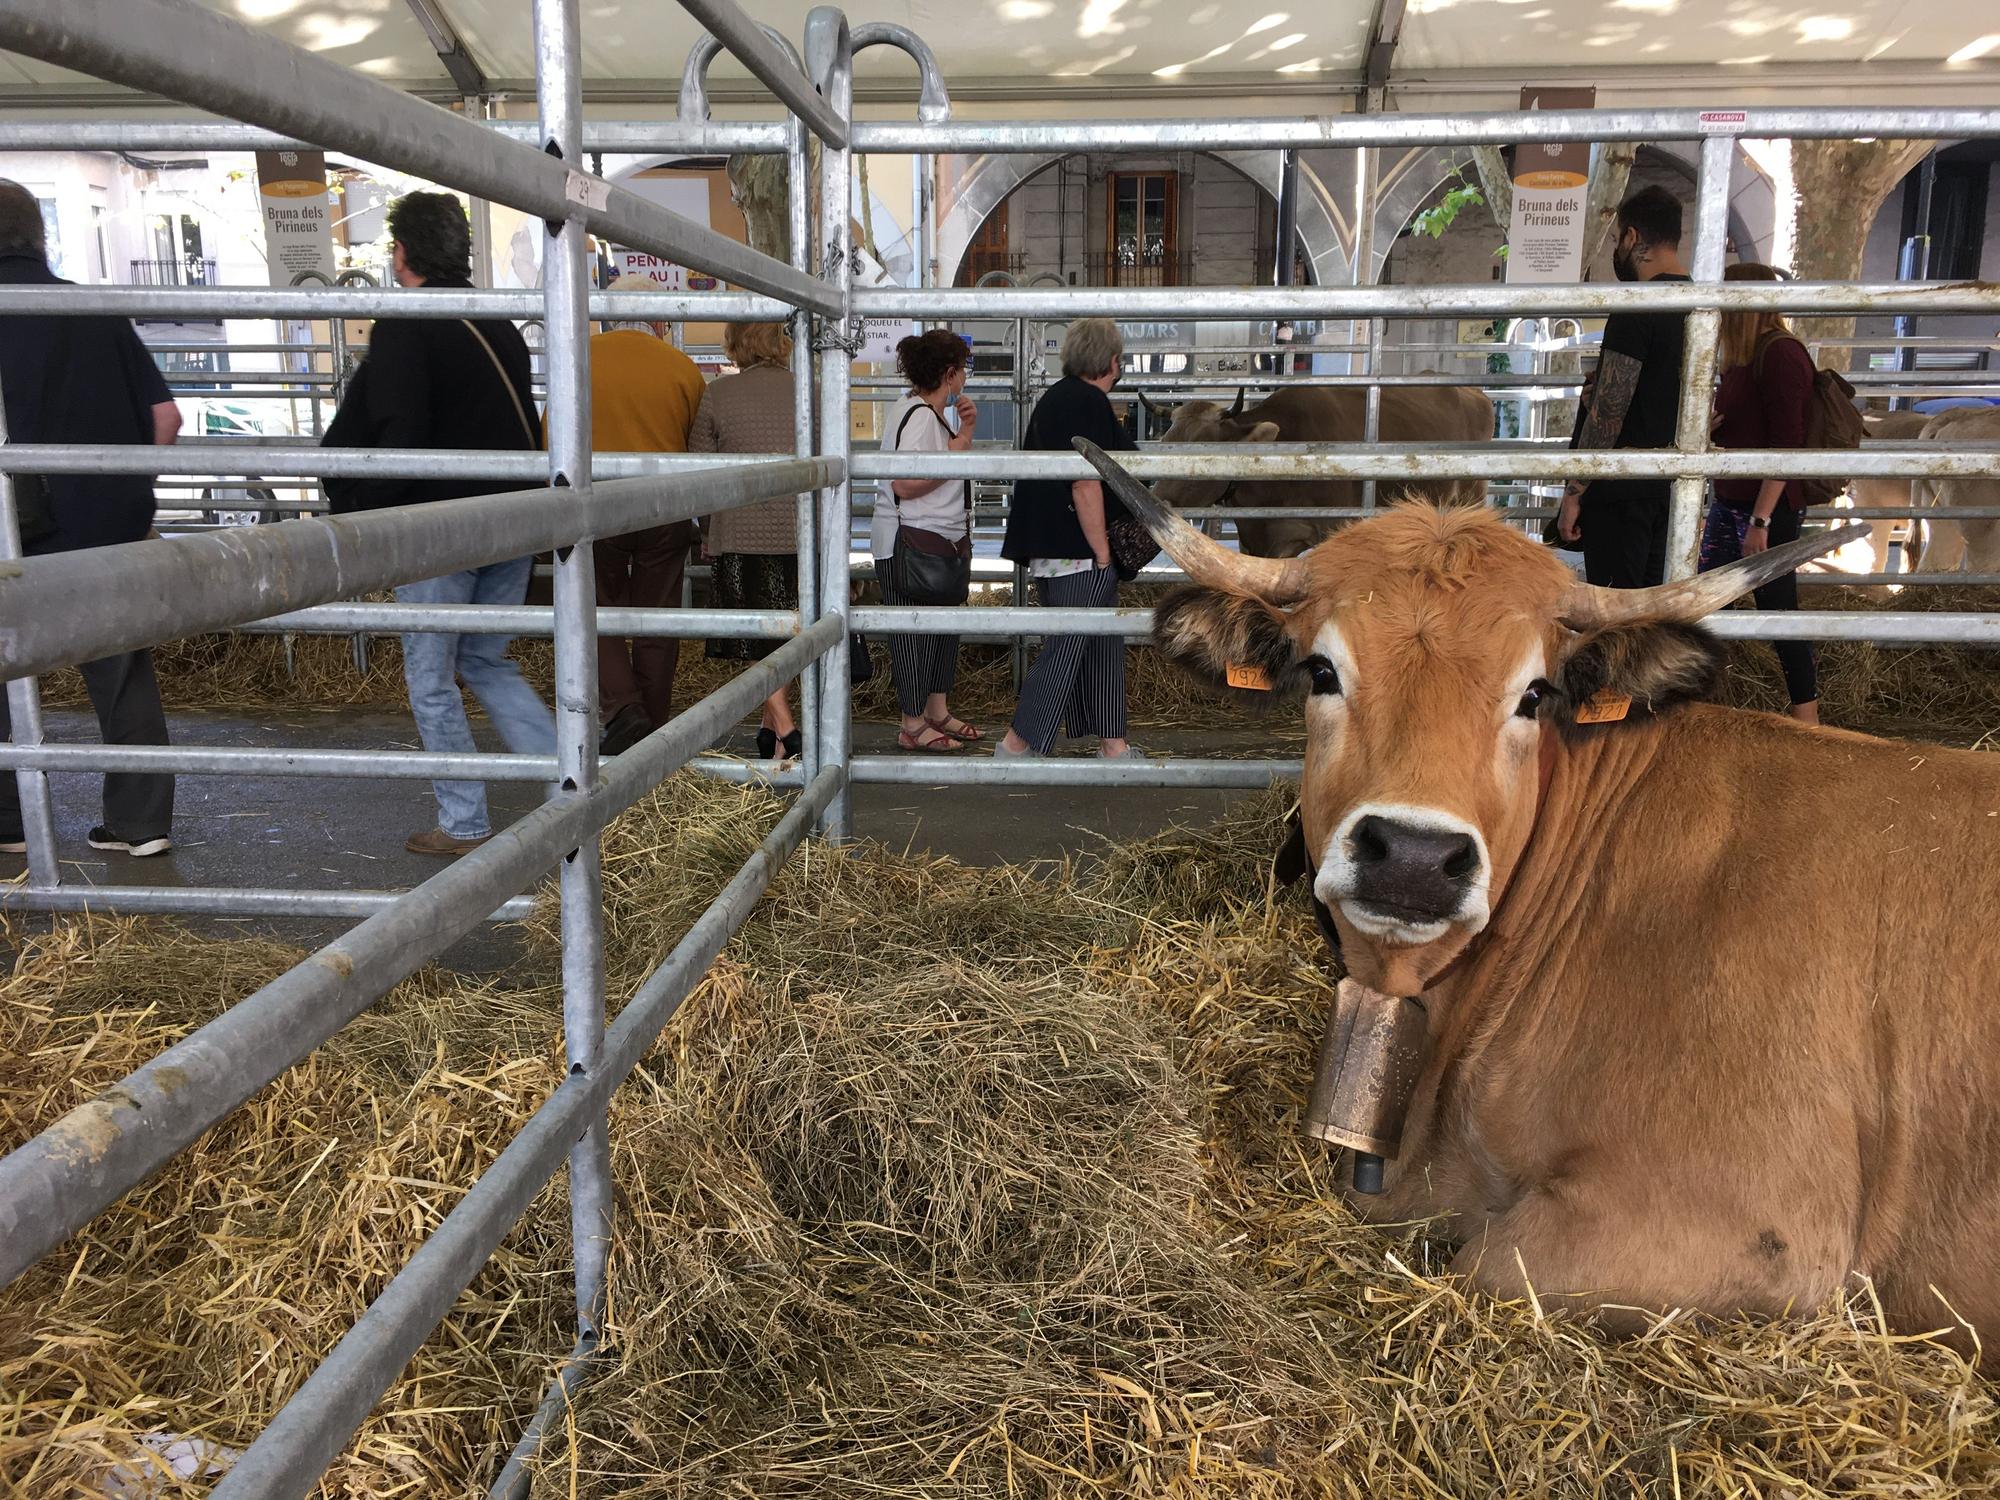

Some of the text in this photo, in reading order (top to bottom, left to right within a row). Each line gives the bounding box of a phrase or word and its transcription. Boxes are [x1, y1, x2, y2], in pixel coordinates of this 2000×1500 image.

[1518, 199, 1579, 212] Bruna dels
[268, 206, 324, 220] Bruna dels
[1523, 213, 1570, 226] Pirineus
[275, 220, 318, 233] Pirineus
[866, 319, 892, 327] OQUEU
[1232, 668, 1261, 687] 792
